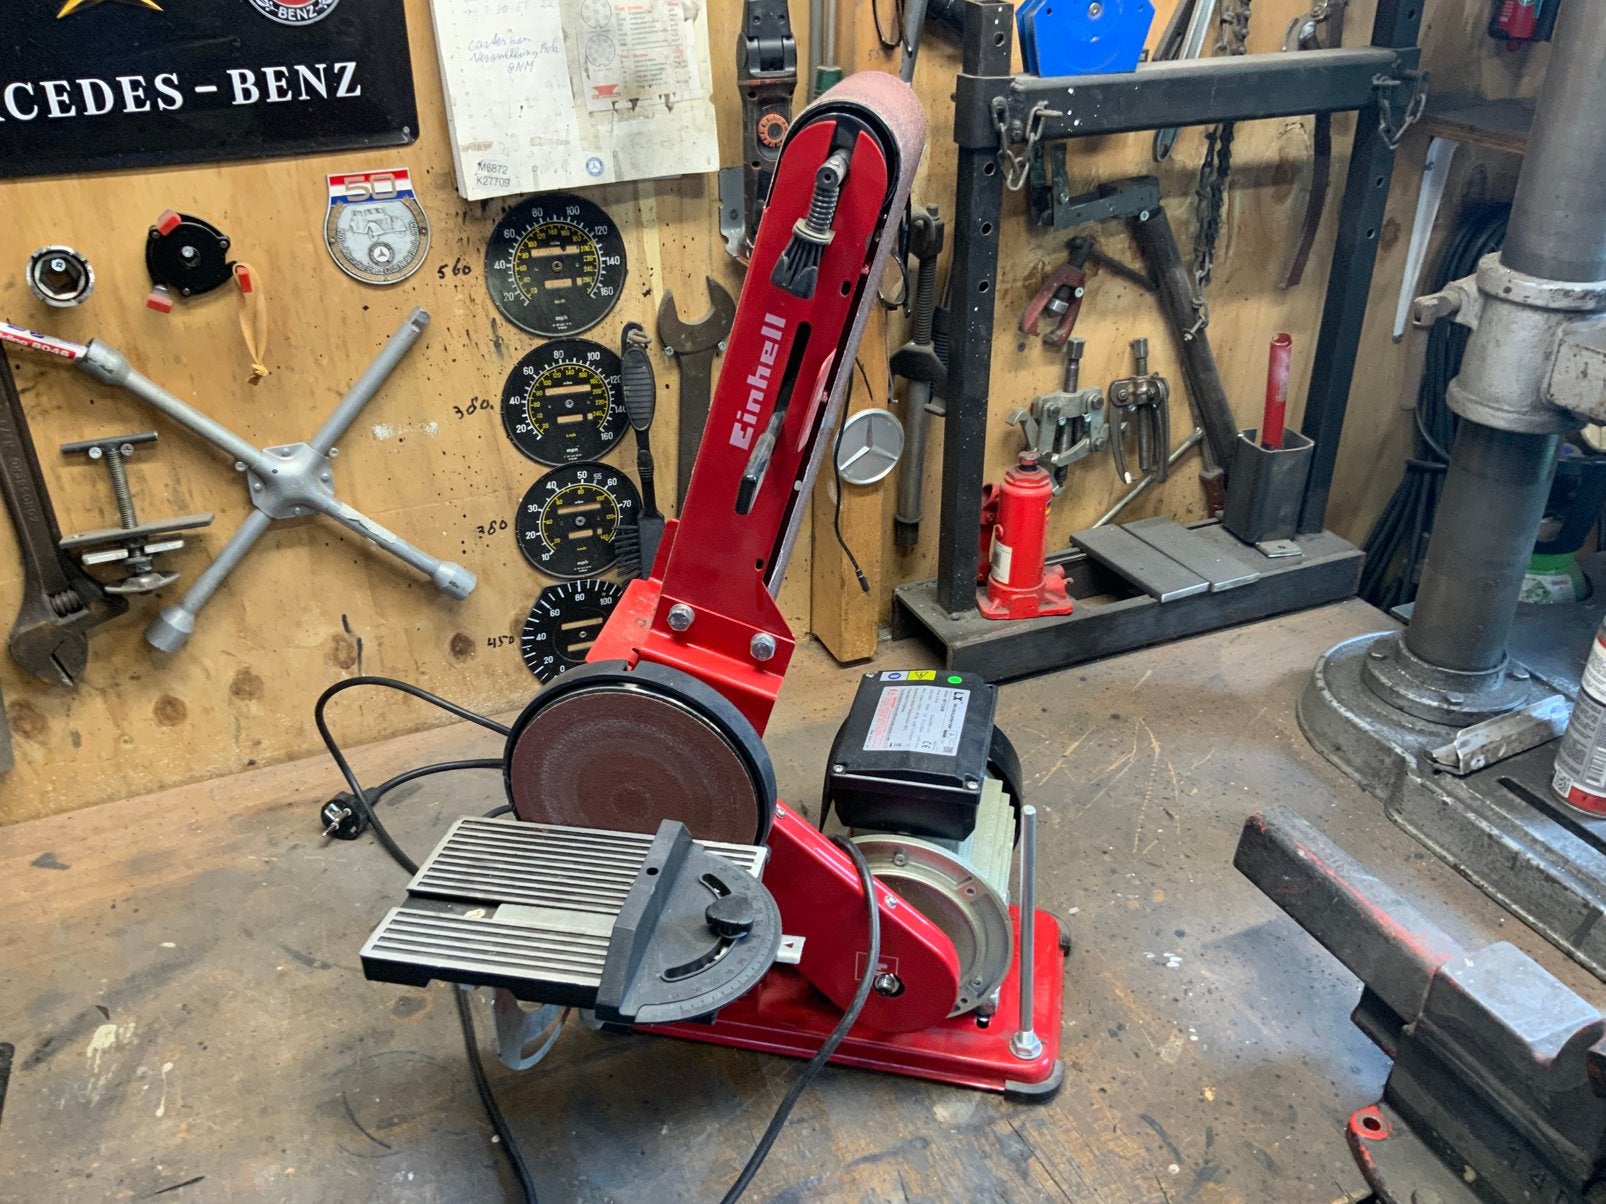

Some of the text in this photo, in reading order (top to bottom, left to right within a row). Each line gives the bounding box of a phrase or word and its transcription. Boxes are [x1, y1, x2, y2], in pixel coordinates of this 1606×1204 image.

[278, 5, 317, 20] BENZ
[478, 163, 509, 175] M6872
[344, 173, 397, 202] 50
[532, 207, 544, 217] 80
[566, 206, 580, 216] 100
[503, 229, 516, 238] 60
[594, 225, 608, 235] 120
[606, 255, 621, 265] 140
[437, 257, 472, 279] 560
[494, 261, 506, 270] 40
[600, 287, 614, 296] 160
[503, 292, 515, 302] 20
[553, 350, 564, 359] 80
[587, 352, 600, 361] 100
[523, 366, 534, 375] 60
[729, 312, 786, 450] Einhell
[509, 396, 521, 405] 40
[516, 424, 527, 433] 20
[601, 432, 614, 441] 160
[576, 471, 587, 479] 50
[546, 481, 557, 489] 40
[607, 478, 617, 486] 60
[622, 500, 632, 508] 70
[525, 531, 536, 539] 20
[541, 553, 550, 561] 10
[575, 593, 585, 601] 80
[600, 597, 612, 605] 100
[550, 609, 560, 617] 60
[536, 632, 546, 640] 40
[543, 656, 554, 664] 20
